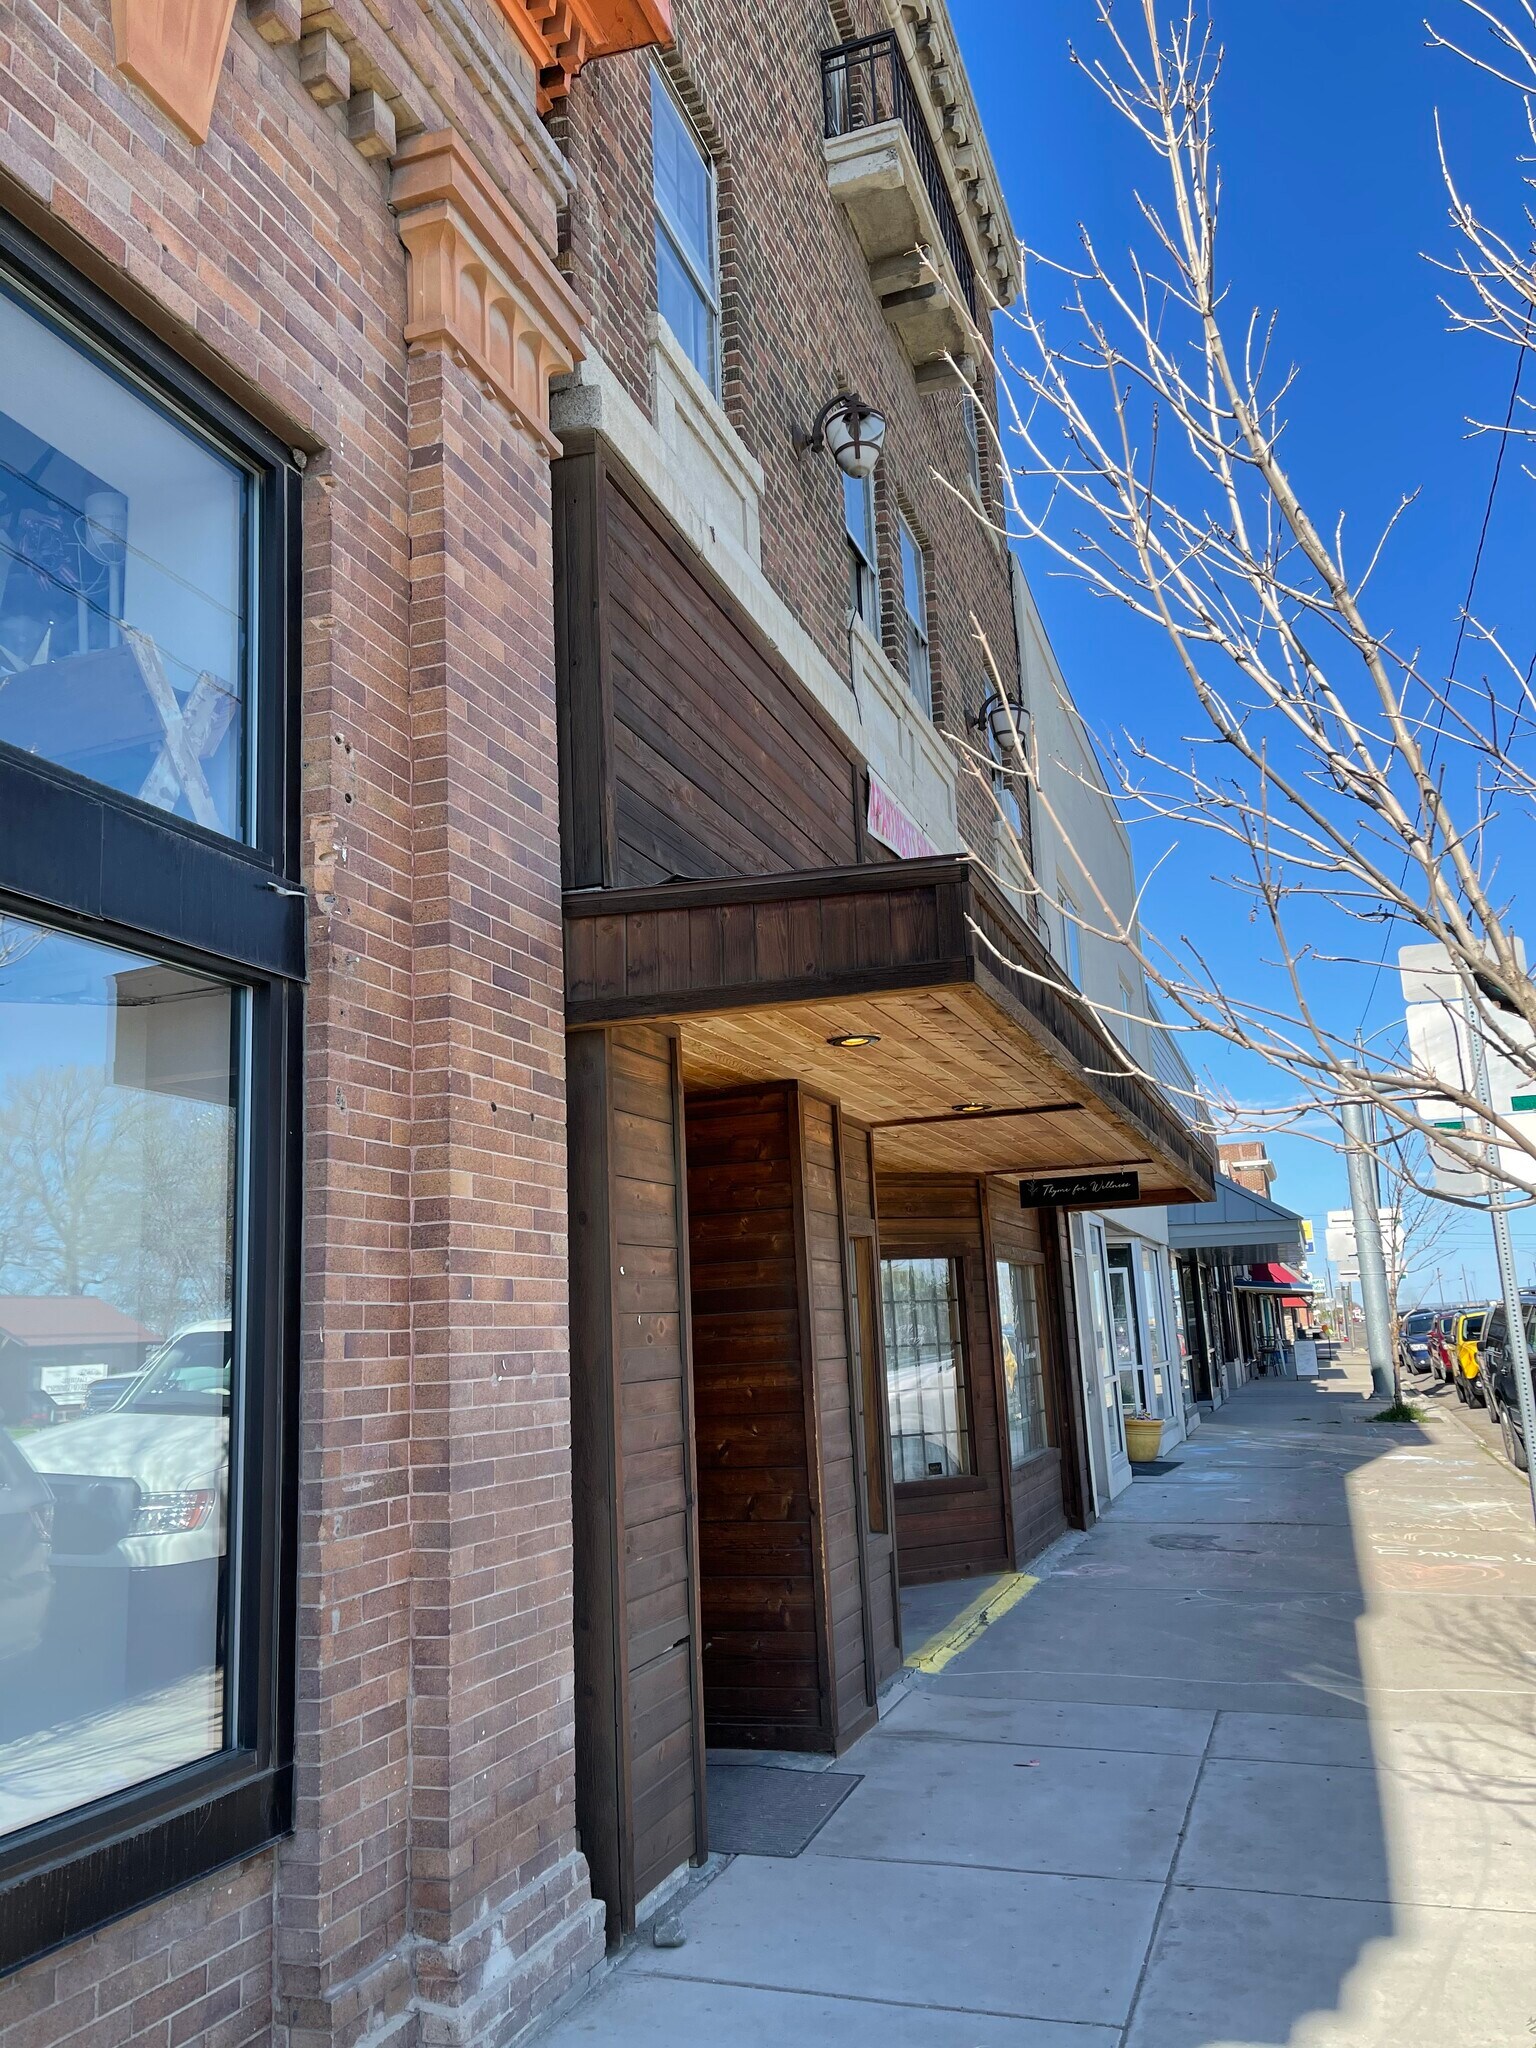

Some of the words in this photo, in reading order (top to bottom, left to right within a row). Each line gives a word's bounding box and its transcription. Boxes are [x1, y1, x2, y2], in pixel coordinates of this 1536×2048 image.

[1042, 1183, 1070, 1198] Thyme
[1072, 1184, 1087, 1196] for
[1089, 1180, 1131, 1193] Wellness
